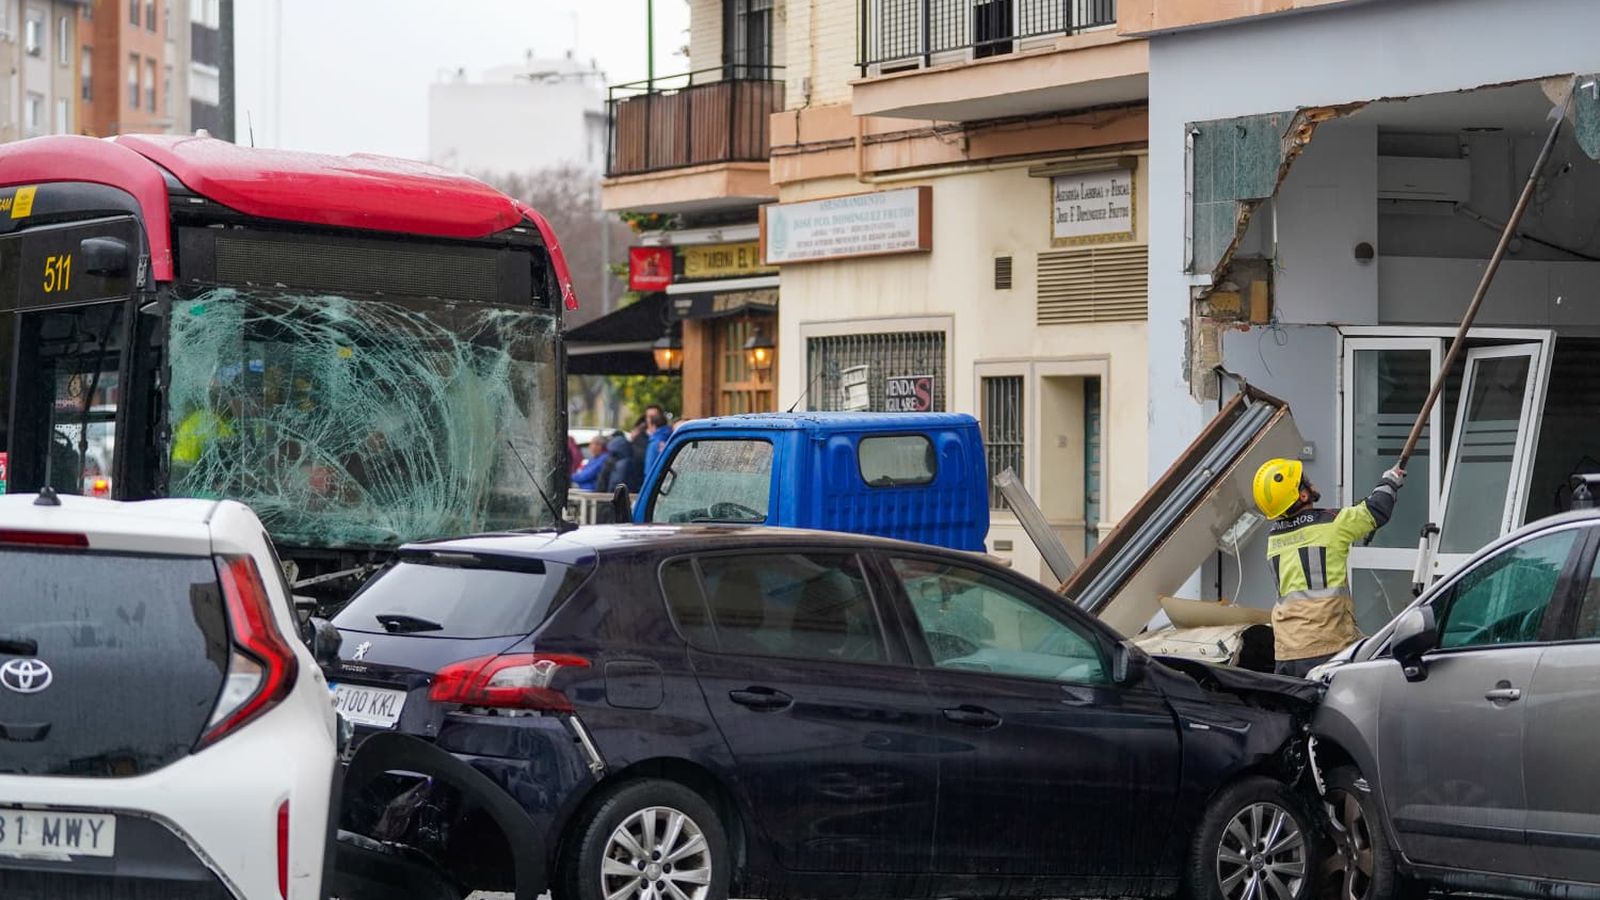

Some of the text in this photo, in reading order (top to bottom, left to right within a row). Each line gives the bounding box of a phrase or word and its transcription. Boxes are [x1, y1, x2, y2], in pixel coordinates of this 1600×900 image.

[43, 254, 72, 293] 511
[368, 692, 397, 717] KKL
[42, 817, 105, 849] MWY
